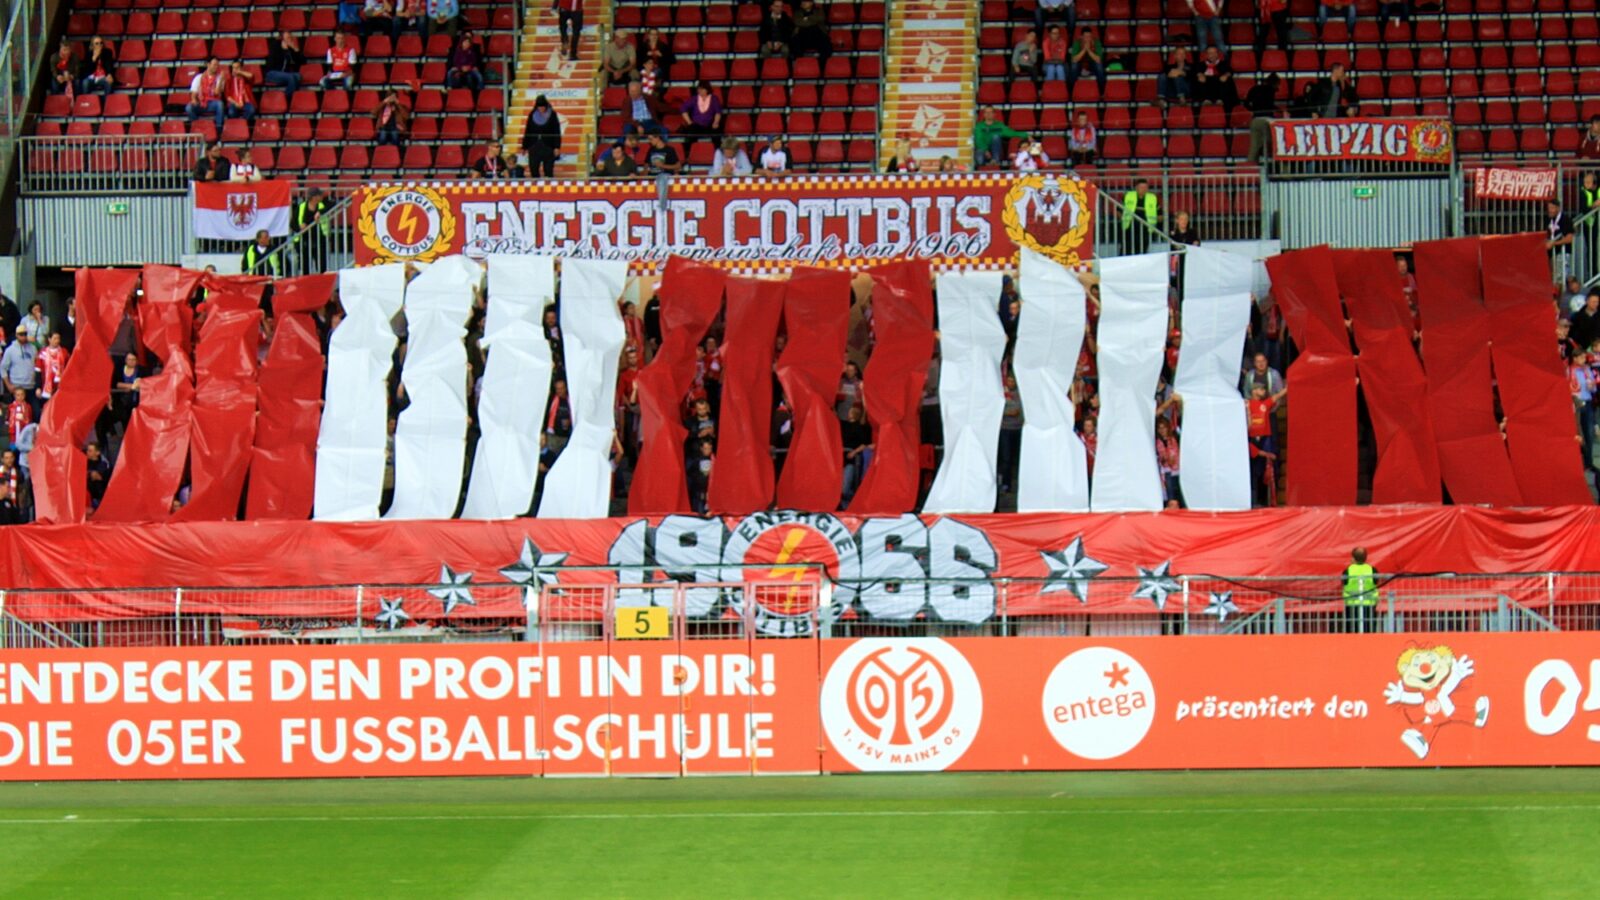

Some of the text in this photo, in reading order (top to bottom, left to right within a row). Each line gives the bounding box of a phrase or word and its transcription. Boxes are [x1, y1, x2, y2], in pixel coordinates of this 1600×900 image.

[1274, 123, 1407, 156] LEIPZIG
[381, 193, 434, 214] ENERGIE
[461, 195, 991, 254] ENERGIE COTTBUS
[381, 235, 434, 254] COTTBUS
[848, 244, 898, 258] von
[908, 232, 988, 258] 1966
[634, 610, 650, 635] 5
[0, 653, 776, 704] NTDECKE DEN PROFI IN DIR!
[1052, 689, 1148, 723] entega
[1175, 694, 1369, 721] präsentiert den
[107, 718, 245, 766] 05ER
[281, 712, 774, 764] FUSSBALLSCHULE
[843, 726, 961, 763] 1. FSV MAINZ 05
